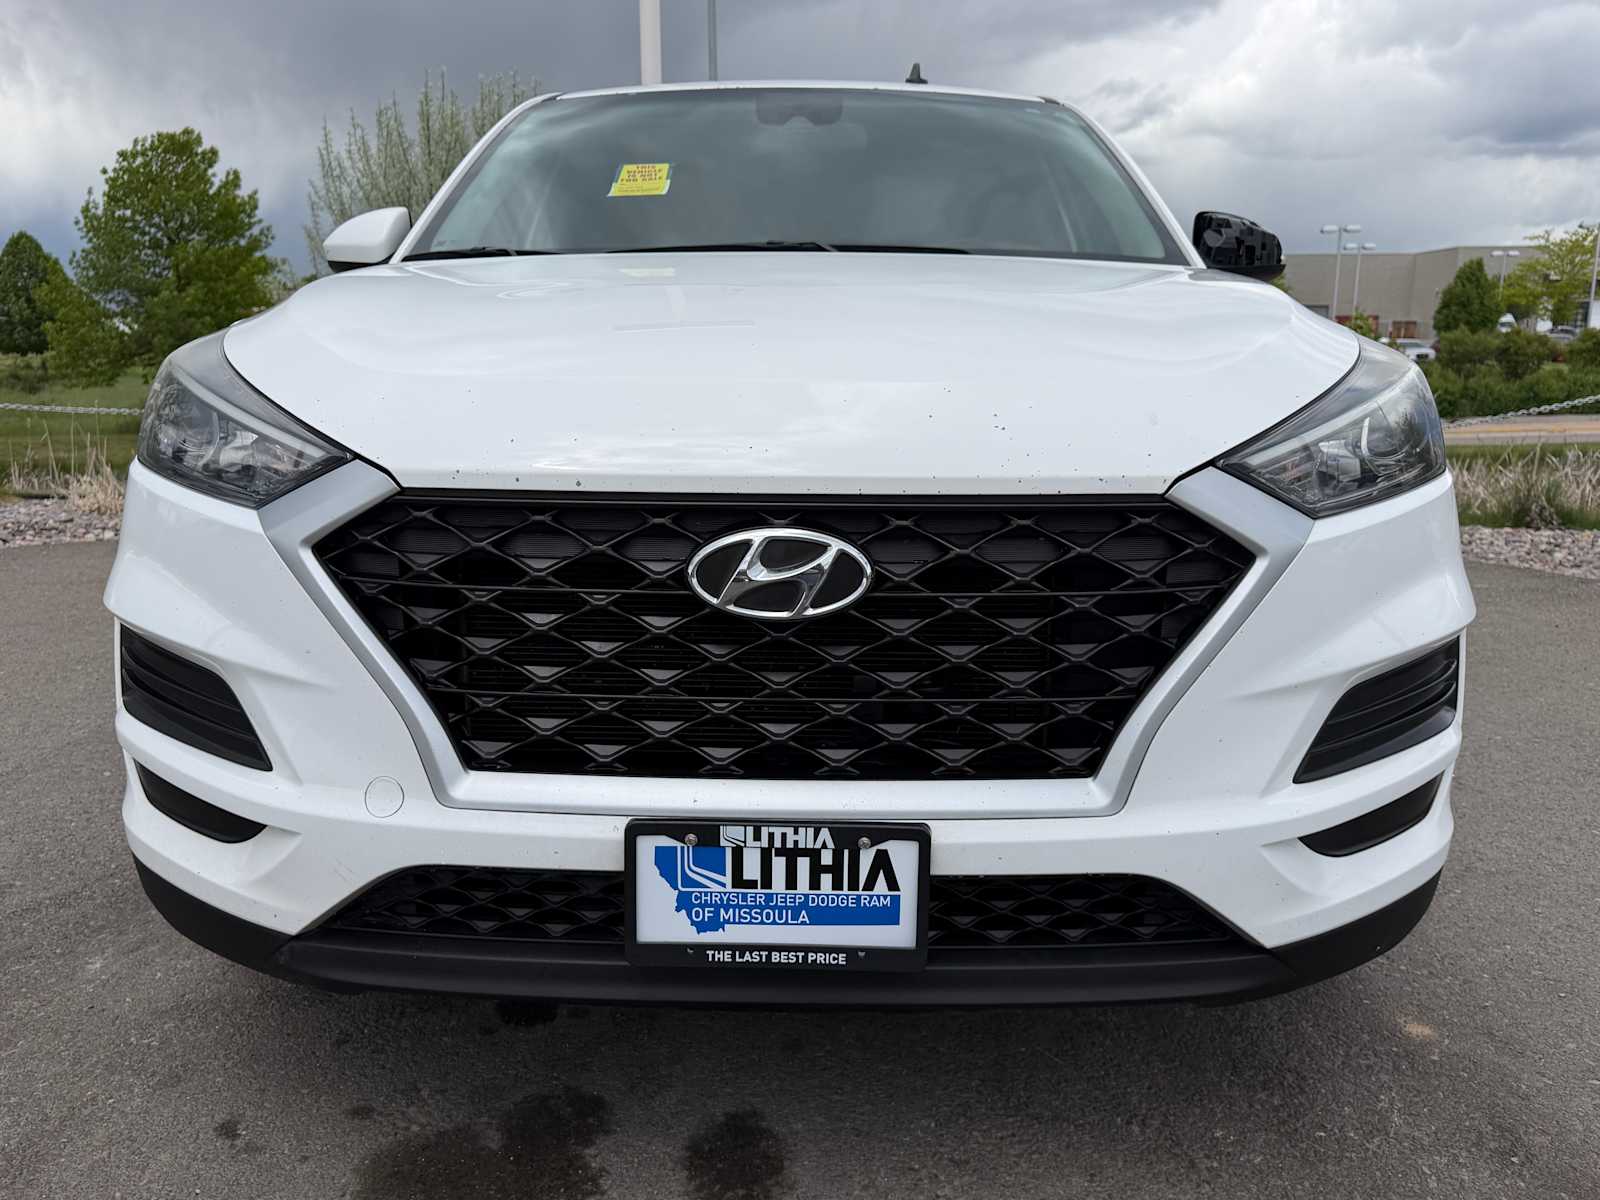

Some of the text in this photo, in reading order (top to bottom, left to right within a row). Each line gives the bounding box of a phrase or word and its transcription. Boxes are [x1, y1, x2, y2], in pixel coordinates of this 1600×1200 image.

[746, 826, 835, 849] LITHIA
[731, 847, 901, 892] LITHIA
[691, 893, 891, 907] CHRYSLER JEEP DODGE RAM
[691, 907, 810, 924] OF MISSOULA
[706, 950, 847, 965] THE LAST BEST PRICE
